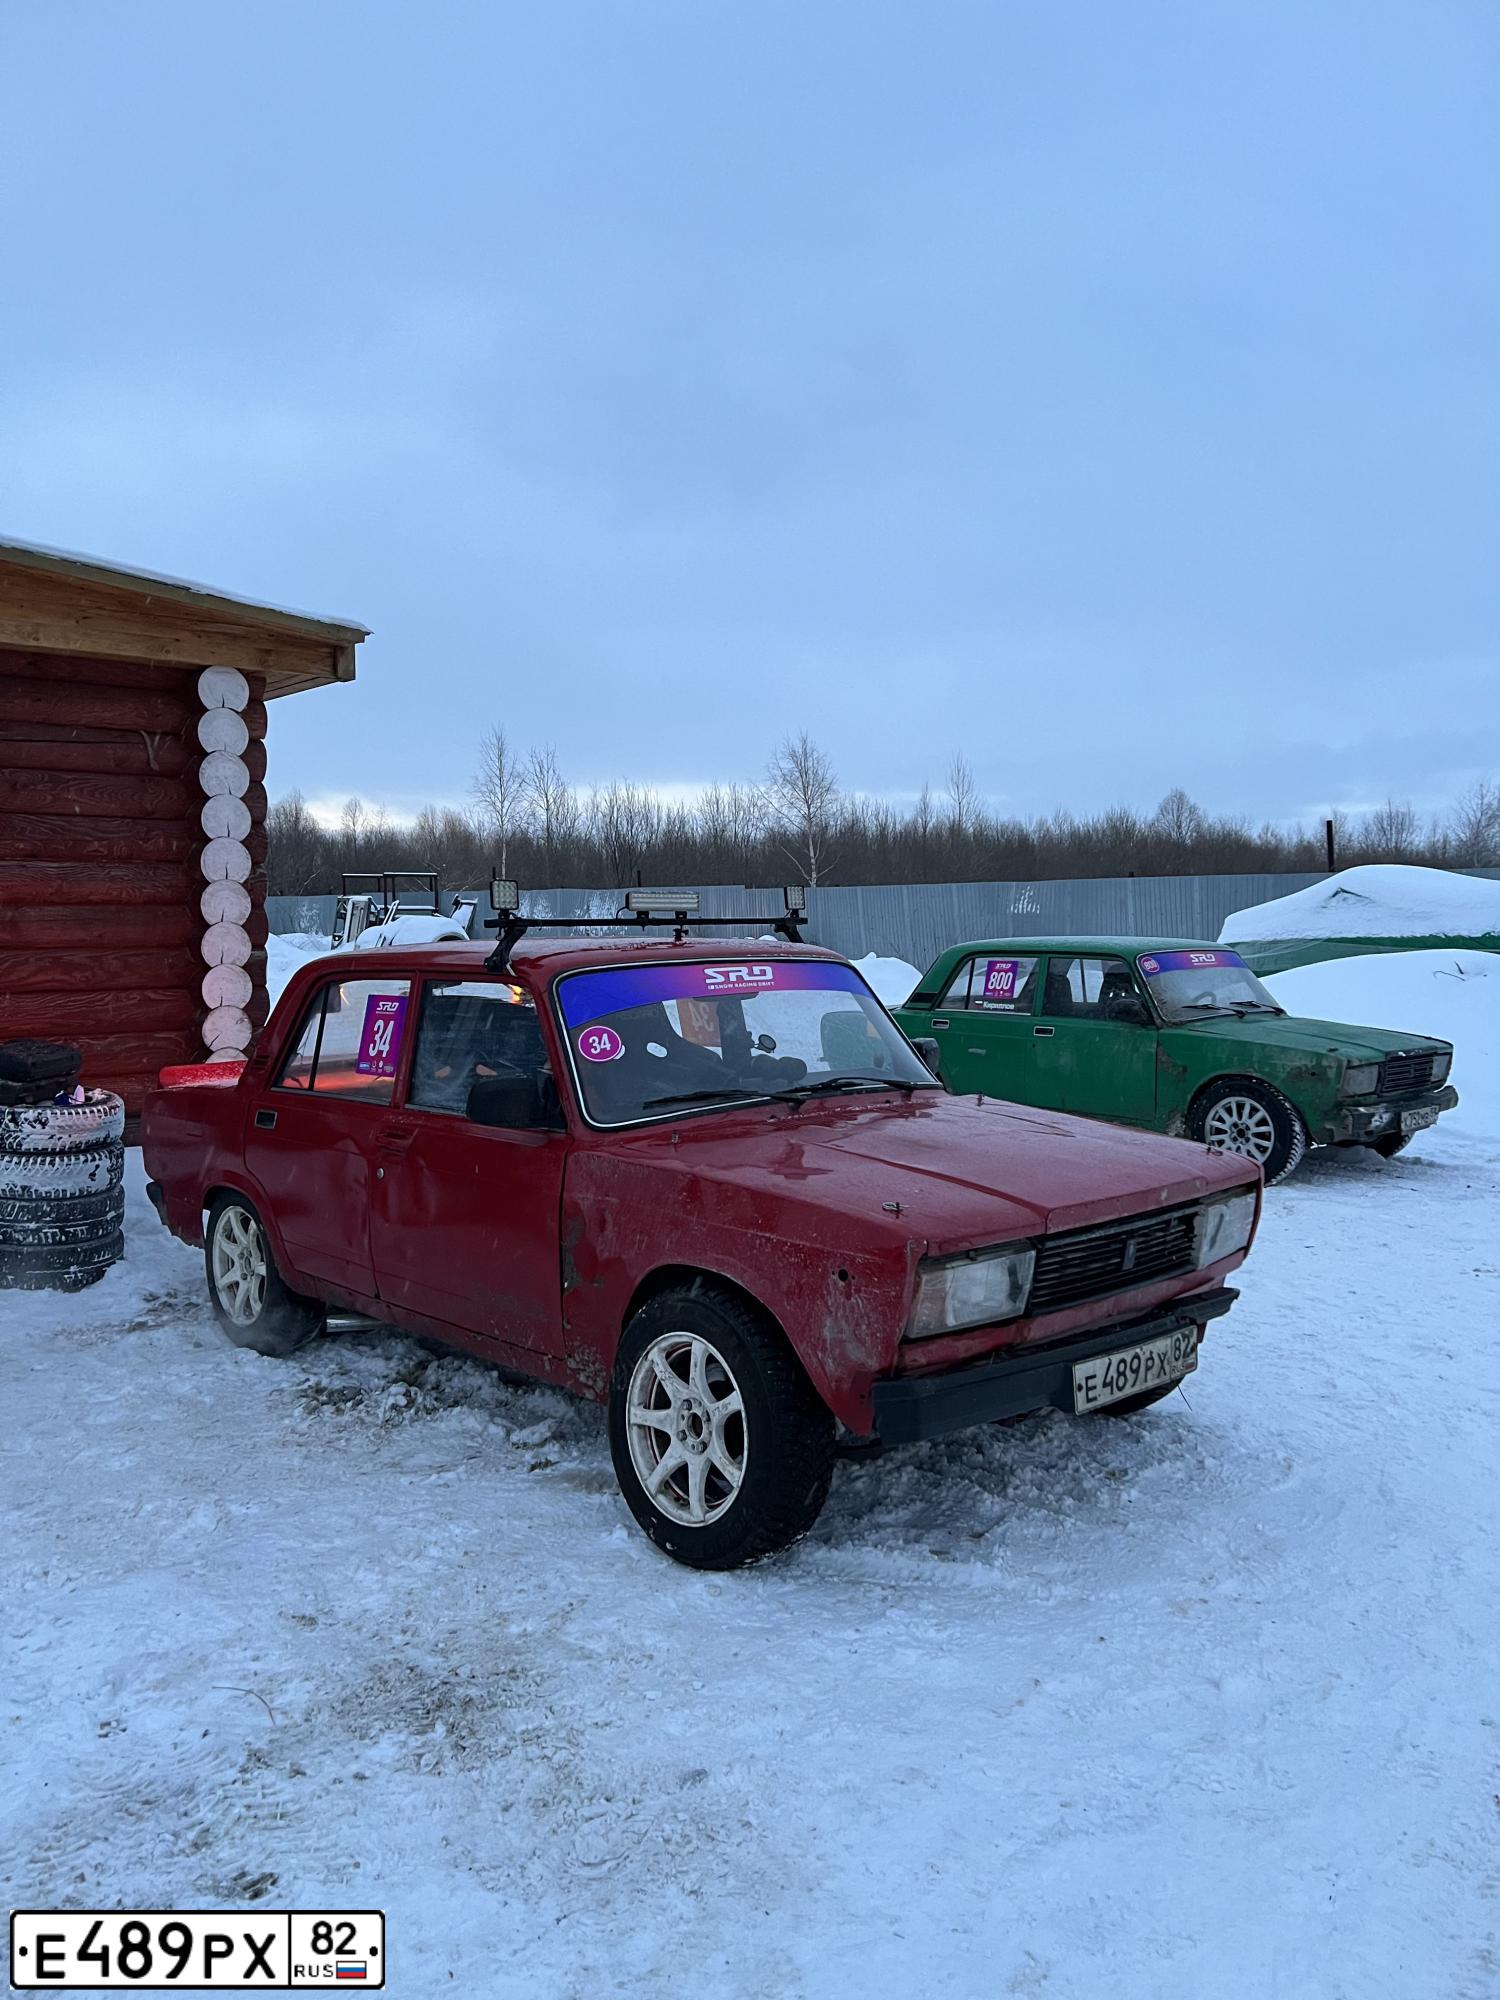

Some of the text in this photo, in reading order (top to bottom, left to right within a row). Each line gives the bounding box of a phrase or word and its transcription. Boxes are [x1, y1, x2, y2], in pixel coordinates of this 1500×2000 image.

[1190, 953, 1216, 962] SRD
[704, 966, 774, 984] SRD
[988, 971, 1013, 990] 800
[376, 1001, 400, 1012] SRD
[368, 1019, 395, 1058] 34
[588, 1033, 611, 1055] 34
[1174, 1334, 1191, 1361] 82
